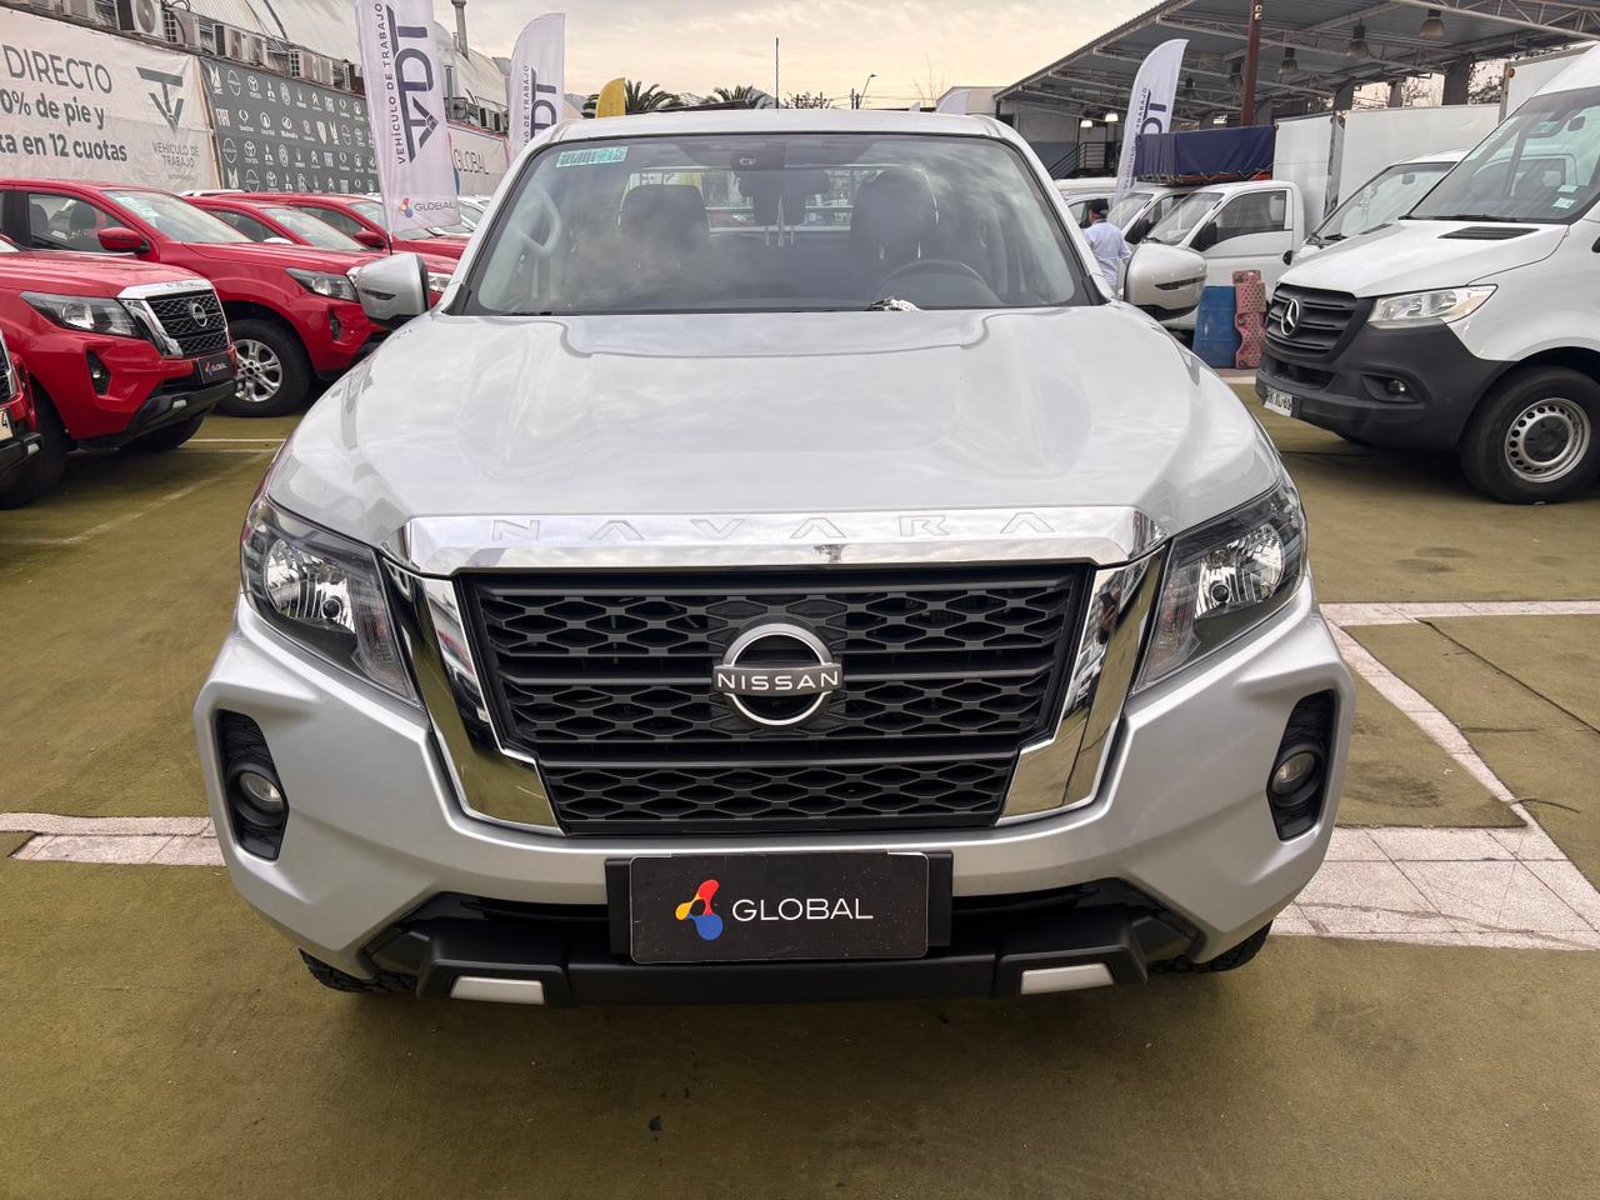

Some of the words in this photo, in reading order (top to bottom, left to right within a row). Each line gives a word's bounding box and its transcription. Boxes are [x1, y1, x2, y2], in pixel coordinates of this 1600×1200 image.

[374, 3, 392, 68] TRABAJO
[2, 44, 113, 94] DIRECTO
[384, 73, 395, 90] DE
[522, 65, 530, 110] TRABAJO
[36, 92, 60, 120] de
[64, 96, 91, 127] pie
[94, 106, 105, 130] y
[22, 135, 46, 156] en
[49, 133, 70, 158] 12
[73, 139, 128, 162] cuotas
[454, 149, 489, 175] GLOBAL
[414, 201, 456, 211] GLOBAL
[491, 511, 1055, 541] NAVARA
[716, 670, 840, 691] NISSAN
[732, 897, 874, 922] GLOBAL
